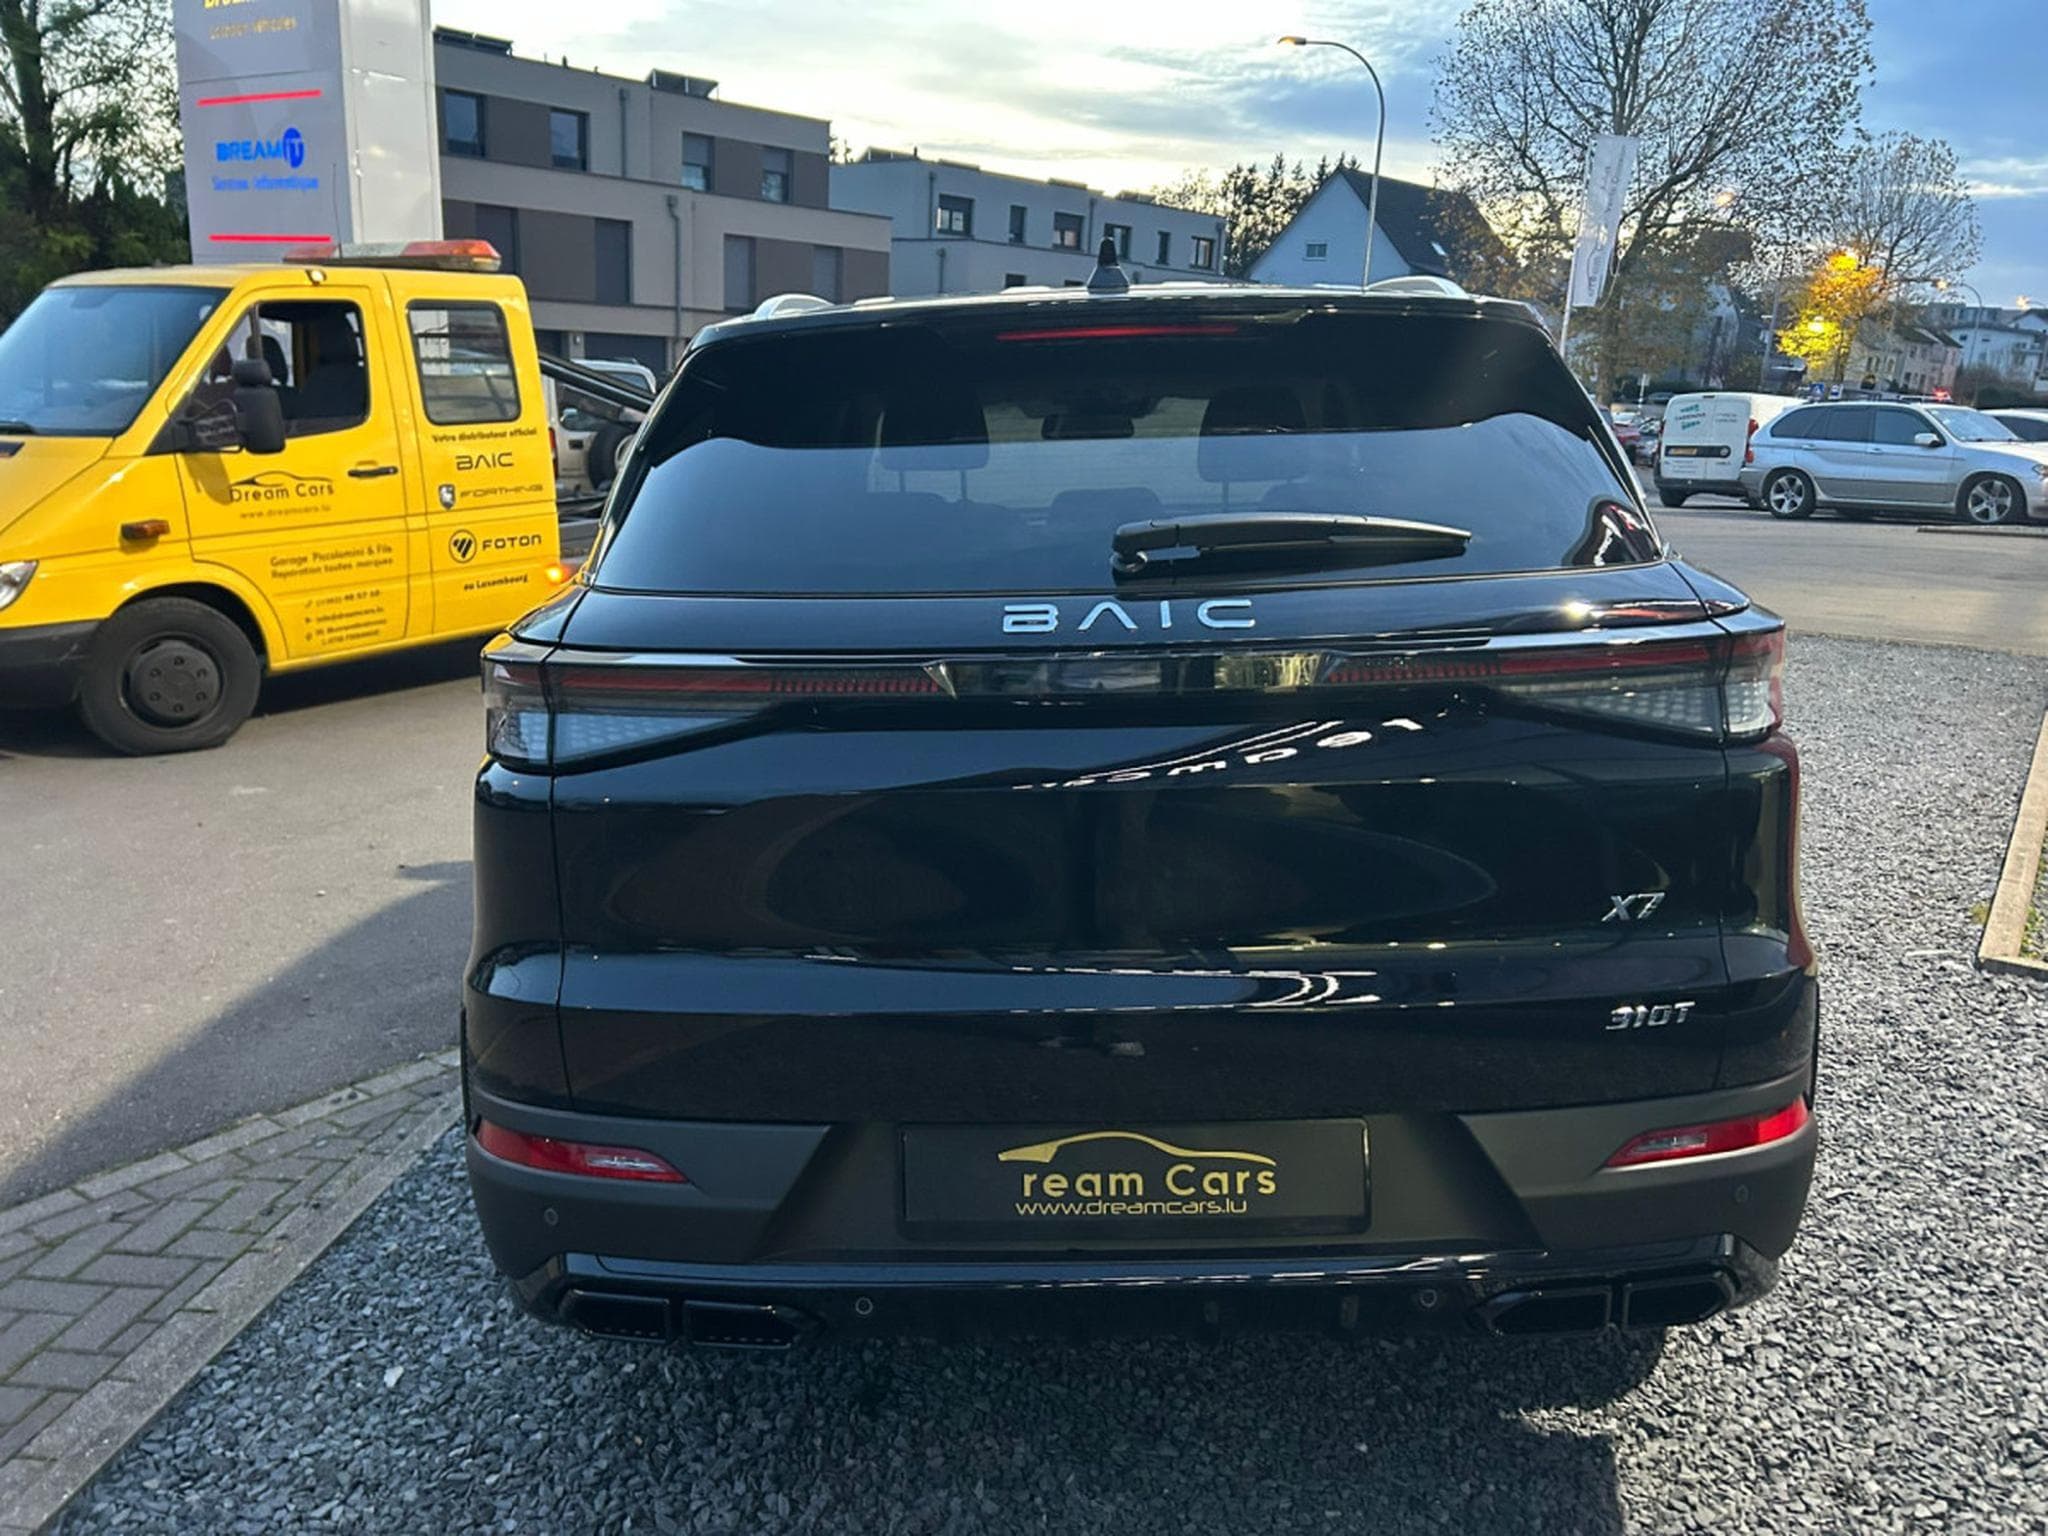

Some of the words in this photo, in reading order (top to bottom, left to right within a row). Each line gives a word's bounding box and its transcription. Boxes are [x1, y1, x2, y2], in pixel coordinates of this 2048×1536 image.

[432, 433, 457, 443] Votre
[458, 429, 508, 441] distributeur
[509, 427, 537, 438] officiel
[456, 452, 514, 471] BAIC
[229, 487, 290, 503] Dream
[295, 482, 335, 497] Cars
[460, 483, 544, 498] FORTHING
[482, 534, 542, 550] FOTON
[270, 555, 308, 567] Garage
[366, 545, 375, 555] &
[324, 562, 354, 573] toutes
[355, 557, 394, 568] marques
[475, 573, 529, 589] Luxembourg
[1002, 600, 1256, 633] BAIC
[1601, 892, 1666, 922] X7
[1605, 1001, 1697, 1031] 310T
[1165, 1163, 1278, 1197] Cars
[1015, 1198, 1249, 1216] www.dreamcars.lu
